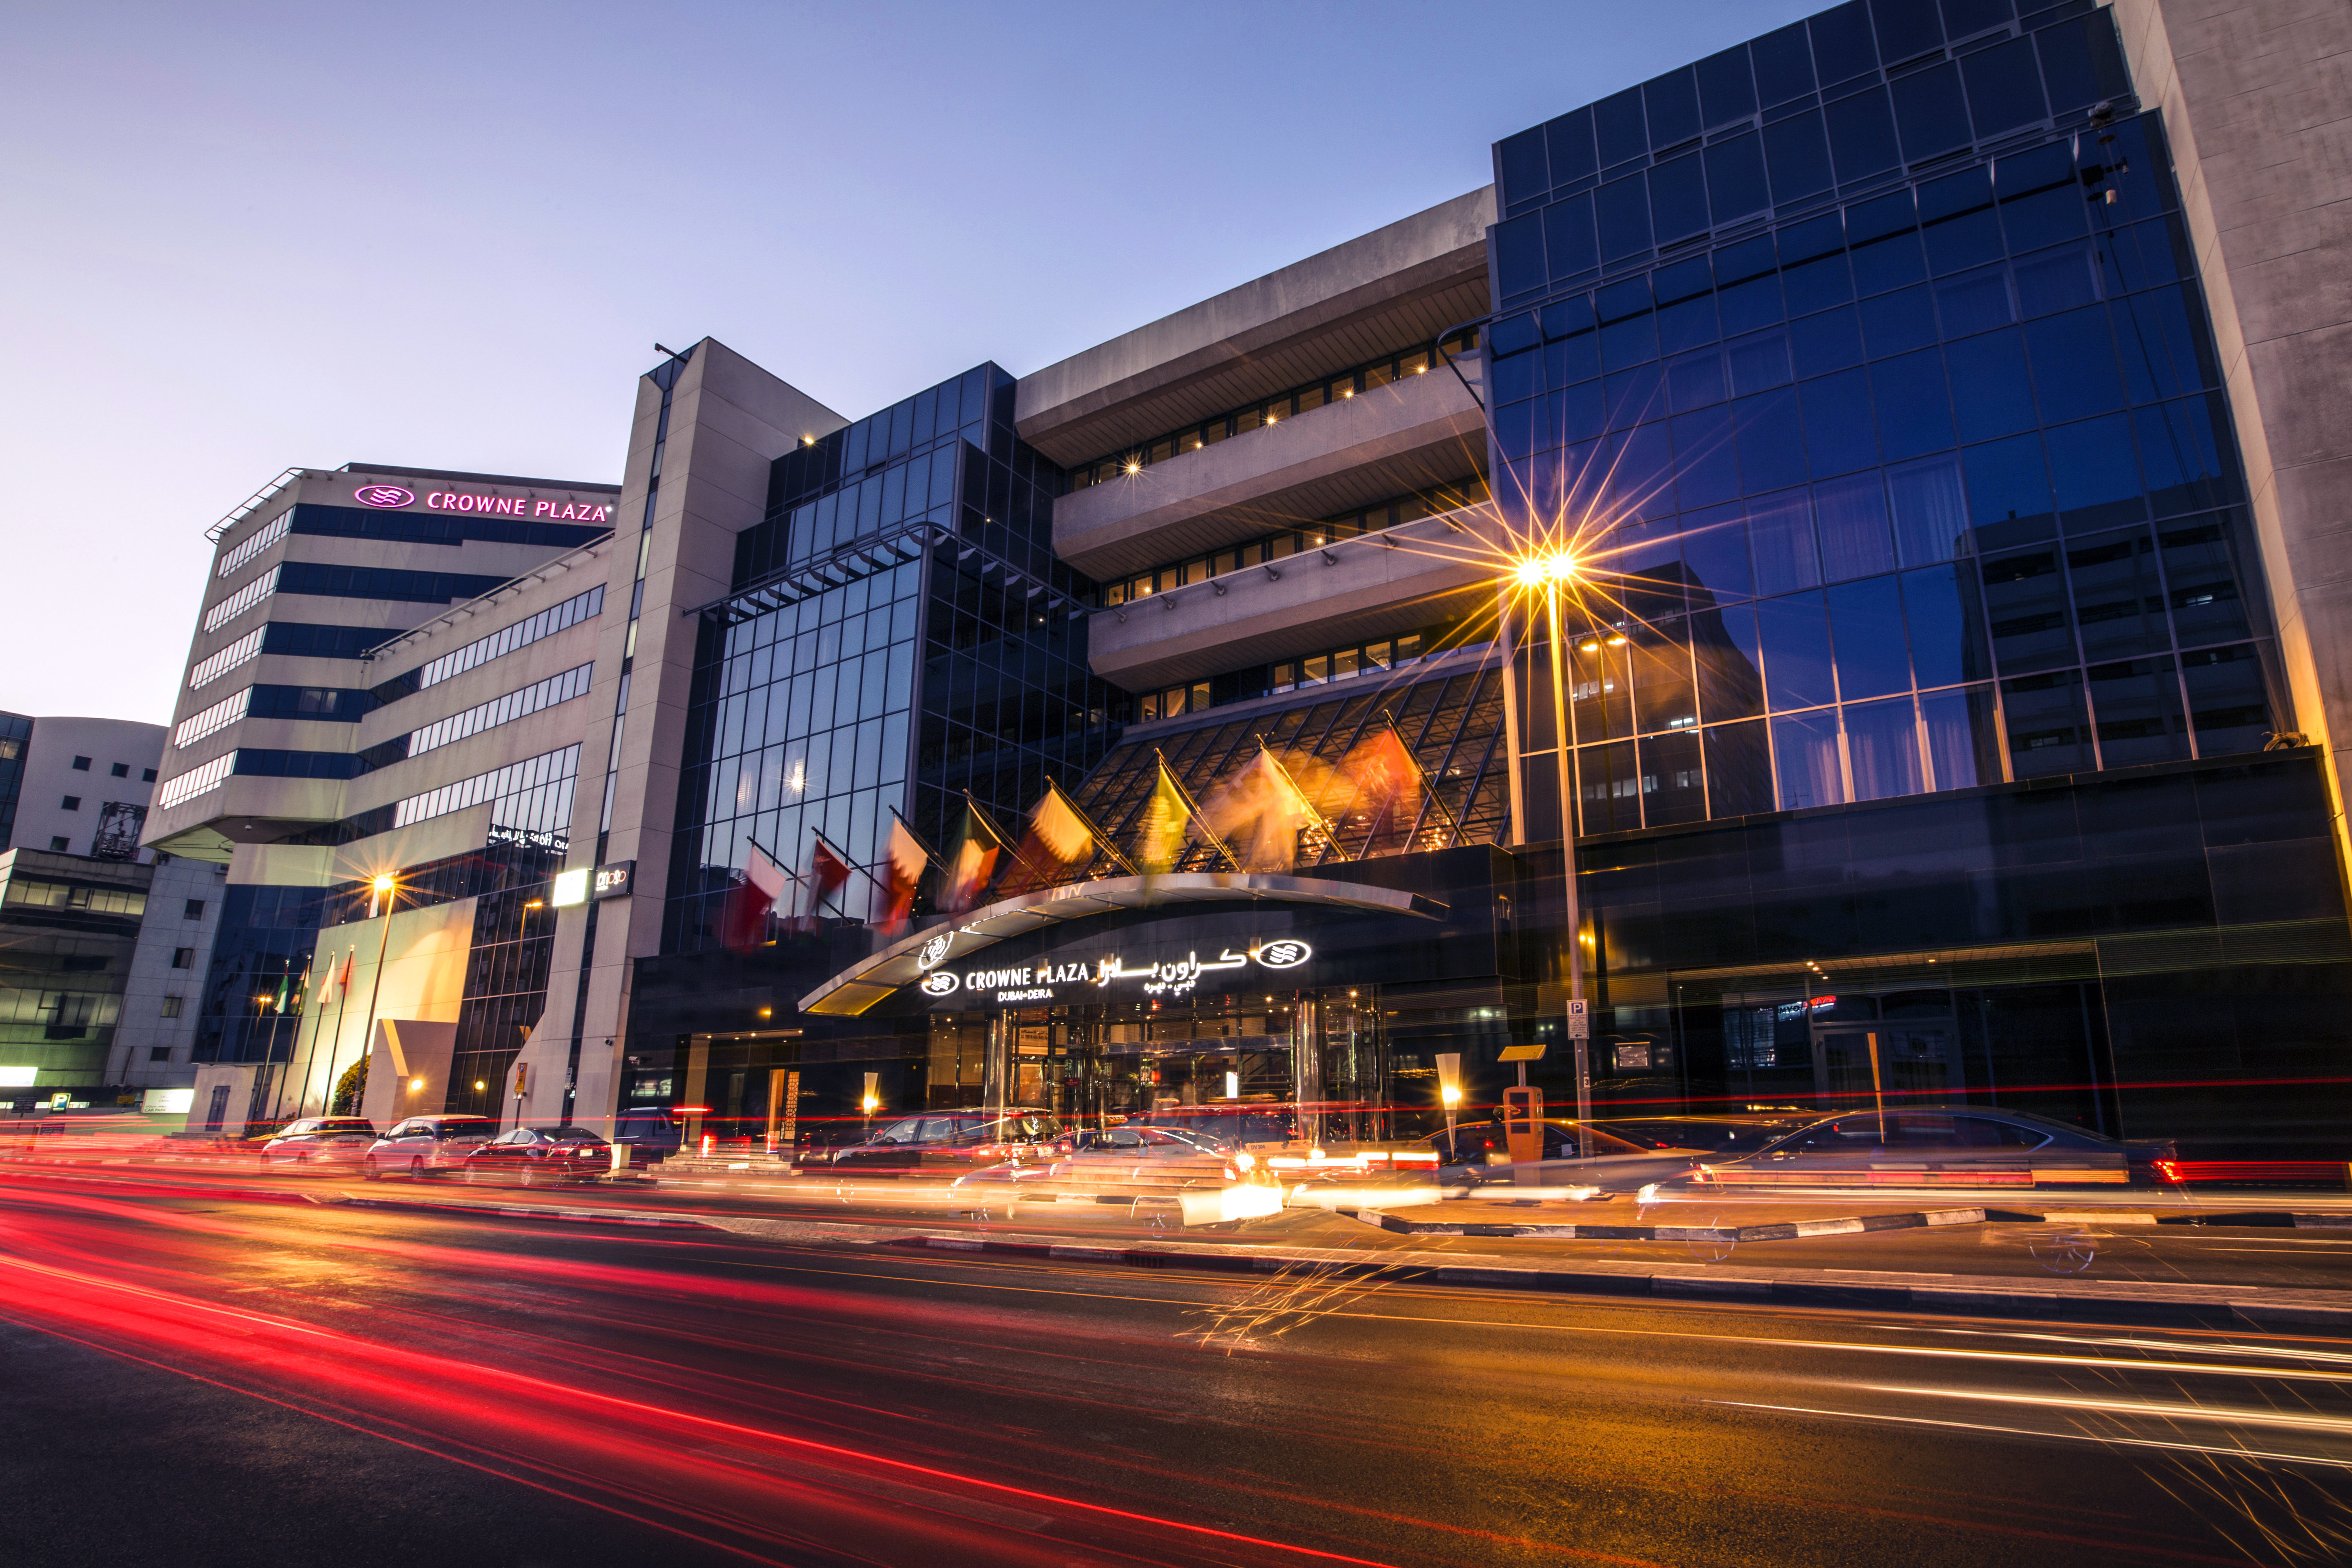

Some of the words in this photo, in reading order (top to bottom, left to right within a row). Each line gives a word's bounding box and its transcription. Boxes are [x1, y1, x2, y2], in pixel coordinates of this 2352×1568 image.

[427, 492, 526, 515] CROWNE
[535, 501, 606, 522] PLAZA
[966, 968, 1031, 990] CROWNE
[1037, 963, 1089, 984] PLAZA
[1161, 949, 1247, 982] كراون
[1573, 1003, 1581, 1013] P
[53, 1094, 67, 1107] P
